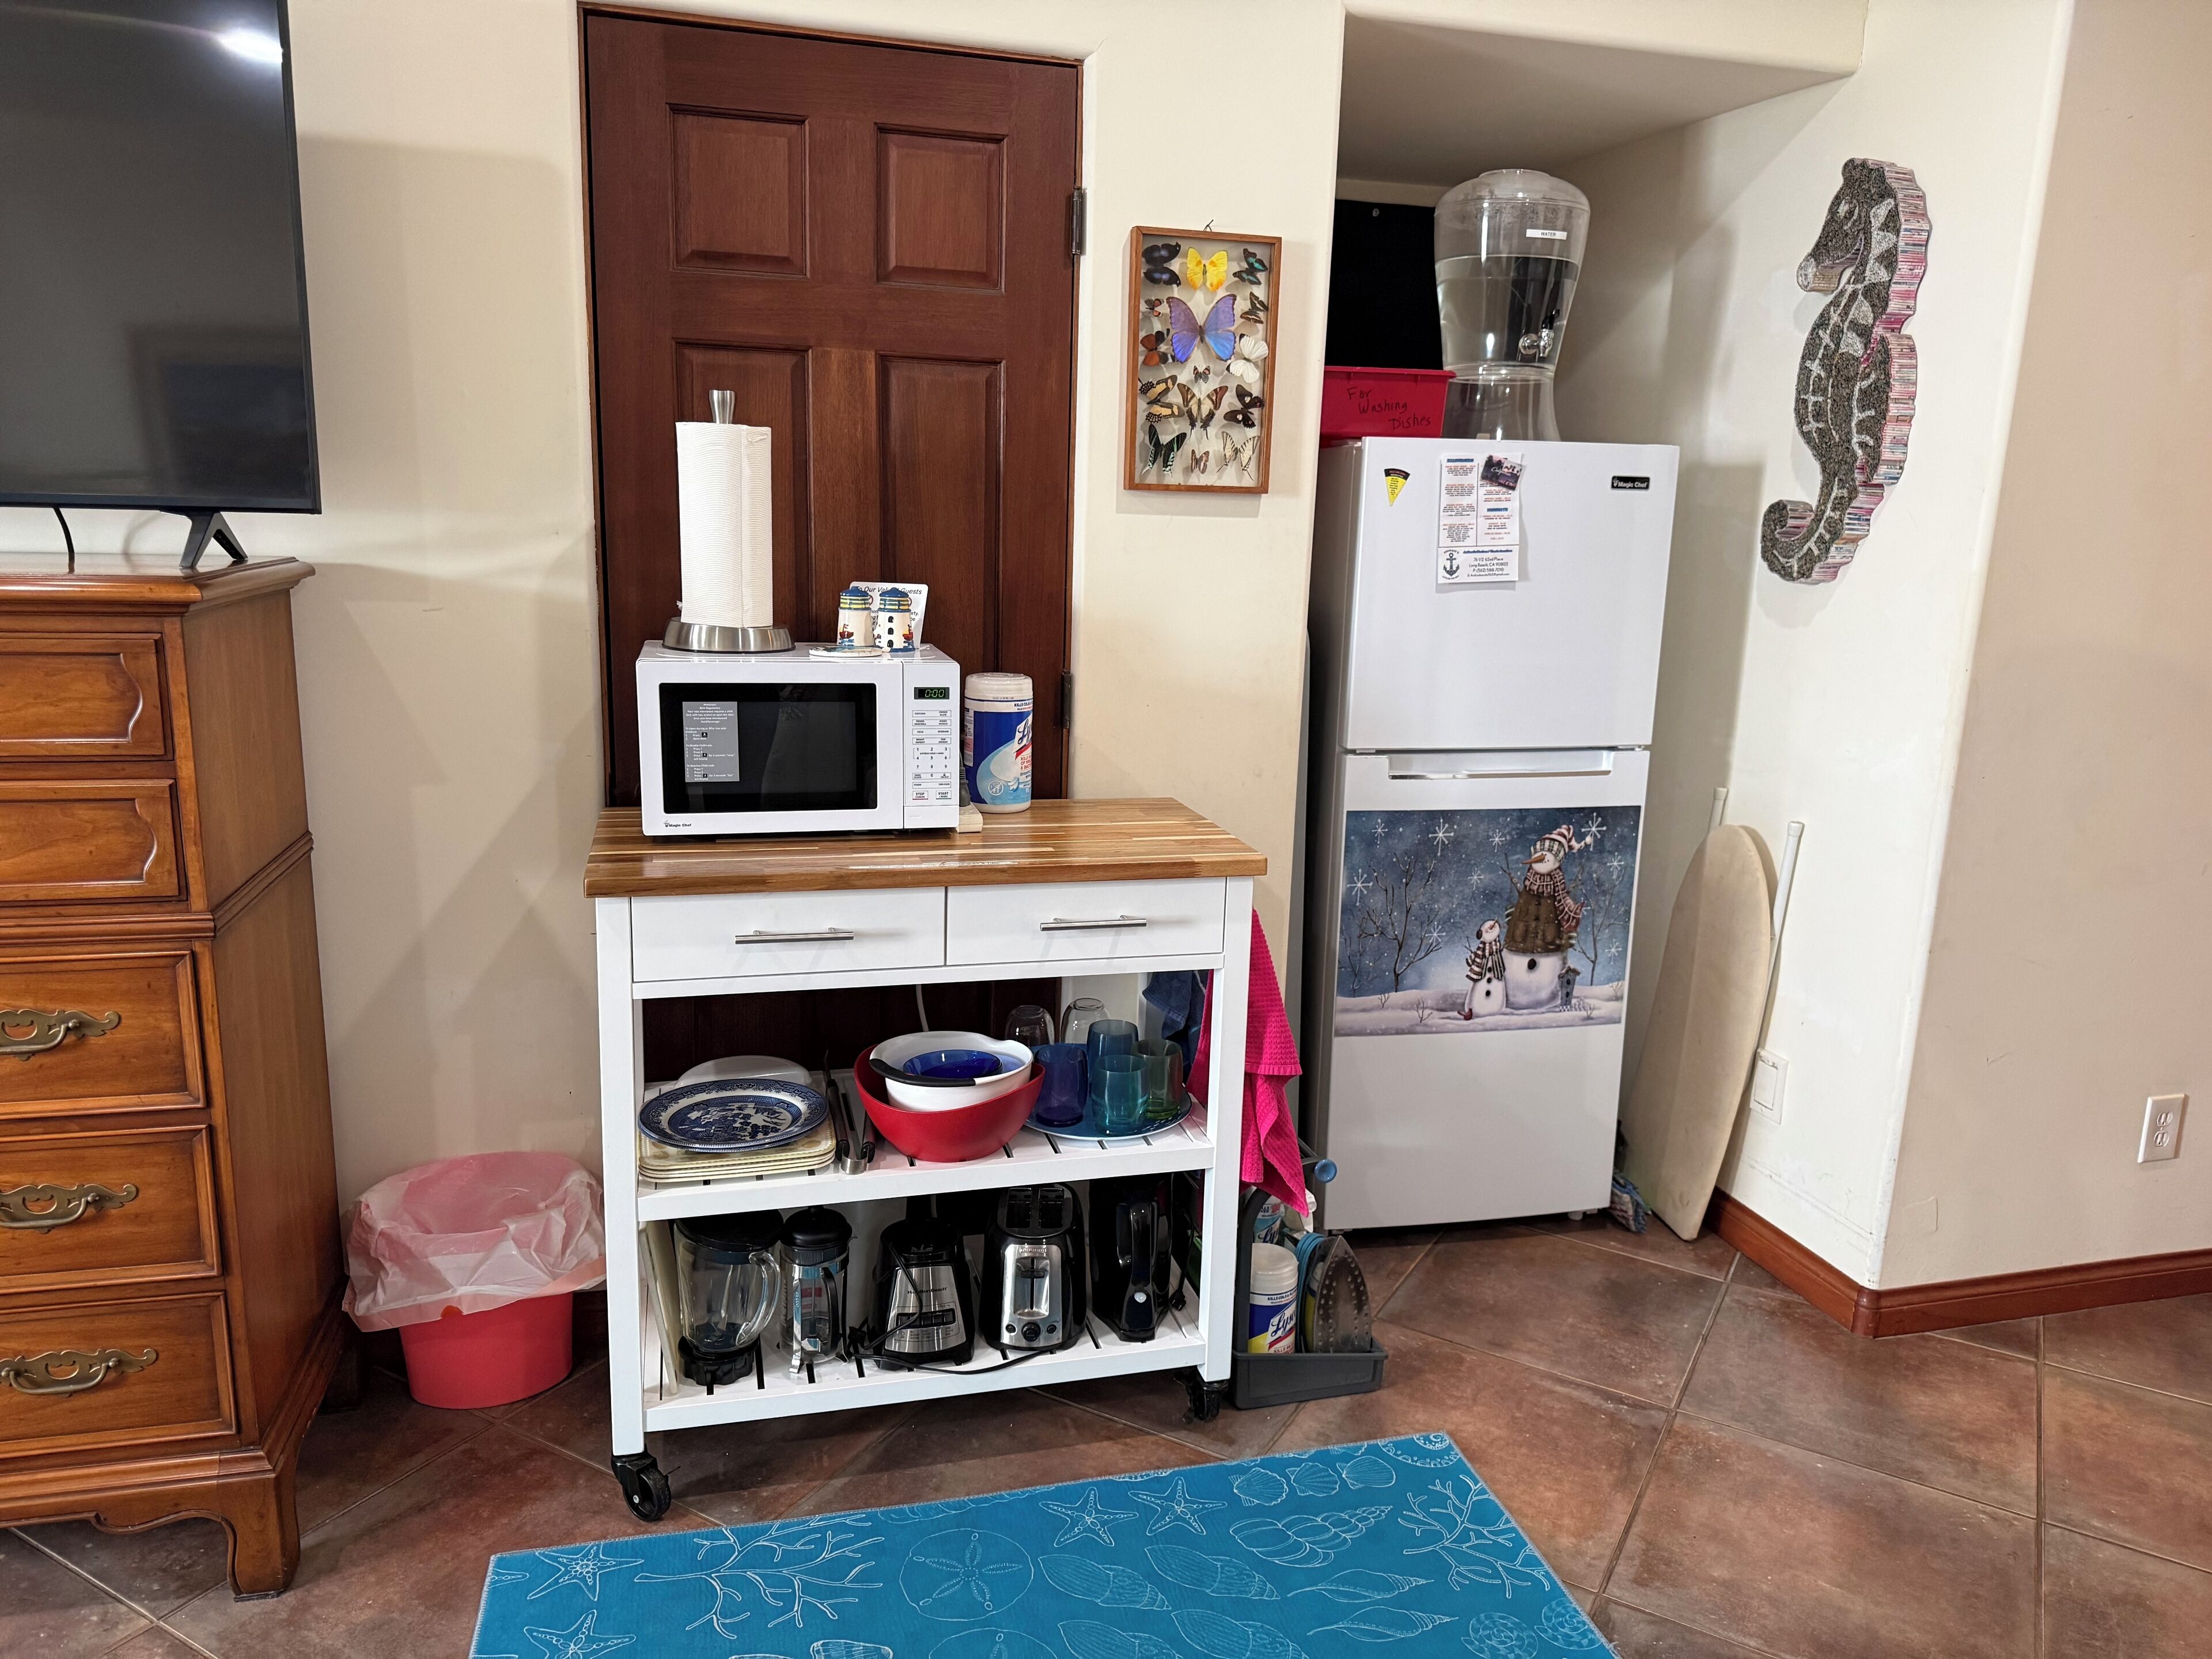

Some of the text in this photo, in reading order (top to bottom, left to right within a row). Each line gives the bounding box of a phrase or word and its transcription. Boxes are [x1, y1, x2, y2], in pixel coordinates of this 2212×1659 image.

[1346, 387, 1372, 400] For
[1358, 399, 1407, 414] Washing
[1388, 413, 1431, 430] Dishes
[925, 690, 945, 698] 0:00
